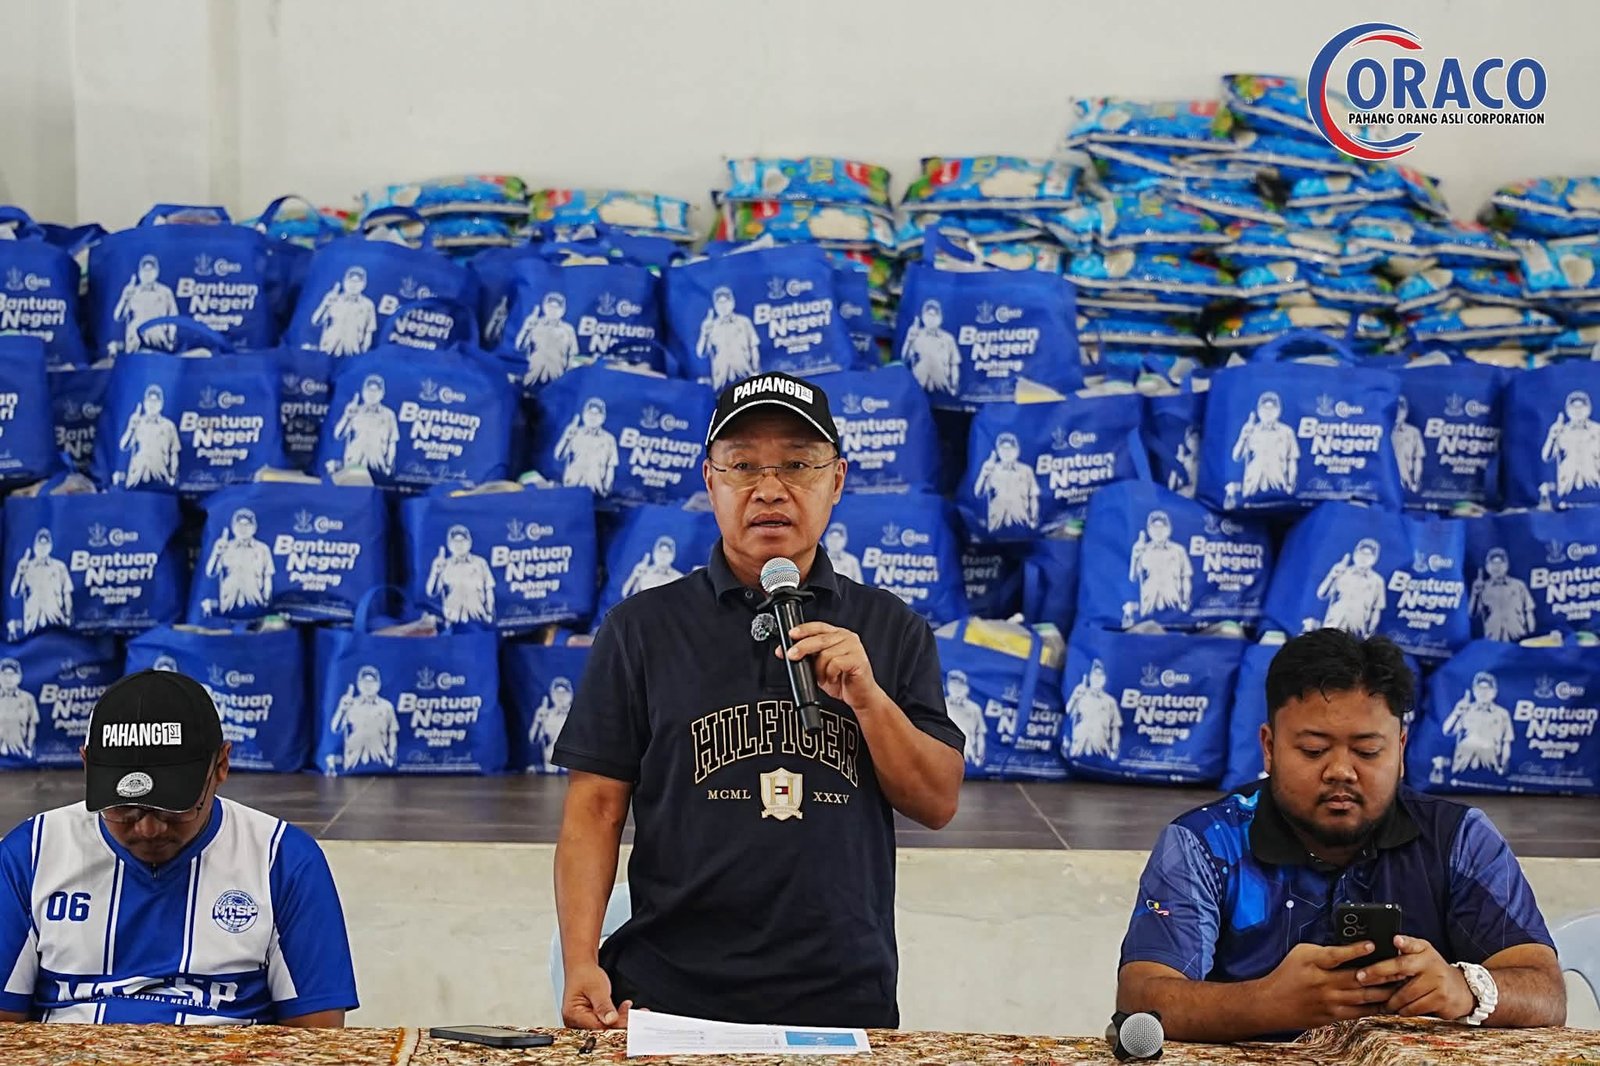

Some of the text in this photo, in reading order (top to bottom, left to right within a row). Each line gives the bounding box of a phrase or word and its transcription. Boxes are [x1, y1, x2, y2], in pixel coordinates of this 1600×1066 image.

[176, 277, 258, 298] Bantuan
[189, 295, 255, 314] Negeri
[754, 298, 833, 325] Bantuan
[1, 310, 65, 328] Negeri
[577, 316, 655, 339] Bantuan
[768, 313, 831, 339] Negeri
[958, 325, 1040, 345] Bantuan
[971, 340, 1035, 361] Negeri
[179, 411, 264, 432] Bantuan
[399, 401, 481, 429] Bantuan
[410, 420, 477, 441] Negeri
[833, 416, 908, 436] Bantuan
[1298, 416, 1383, 439] Bantuan
[192, 427, 260, 447] Negeri
[619, 427, 702, 455] Bantuan
[842, 430, 906, 451] Negeri
[1310, 434, 1381, 455] Negeri
[196, 447, 249, 461] Pahang
[412, 439, 464, 457] Pahang
[629, 446, 697, 469] Negeri
[1036, 452, 1115, 475] Bantuan
[1314, 454, 1366, 469] Pahang
[1050, 465, 1114, 489] Negeri
[1054, 485, 1100, 499] Pahan
[273, 534, 360, 555] Bantuan
[1190, 535, 1263, 556] Bantuan
[70, 550, 158, 571] Bantuan
[286, 552, 356, 572] Negeri
[491, 545, 572, 567] Bantuan
[1203, 553, 1262, 572] Negeri
[85, 566, 153, 587] Negeri
[289, 571, 342, 587] Pahang
[505, 559, 569, 582] Negeri
[873, 565, 939, 585] Negeri
[1207, 572, 1254, 585] Pahang
[90, 585, 142, 598] Pahang
[510, 579, 560, 593] Pahang
[1387, 570, 1464, 594] Bantuan
[1546, 581, 1600, 604] Nege
[1397, 590, 1462, 609] Negeri
[40, 684, 106, 704] Bantua
[397, 692, 482, 713] Bantuan
[1120, 688, 1209, 709] Bantuan
[410, 709, 478, 728] Negeri
[1134, 707, 1203, 725] Negeri
[1513, 700, 1599, 721] Bantuan
[415, 727, 467, 741] Pahang
[1137, 724, 1190, 741] Pahang
[1526, 719, 1595, 739] Negeri
[691, 700, 859, 788] HILFIGER
[1528, 738, 1580, 753] Pahang
[707, 790, 751, 800] MCML
[813, 791, 850, 804] XXXV
[46, 891, 91, 921] 06
